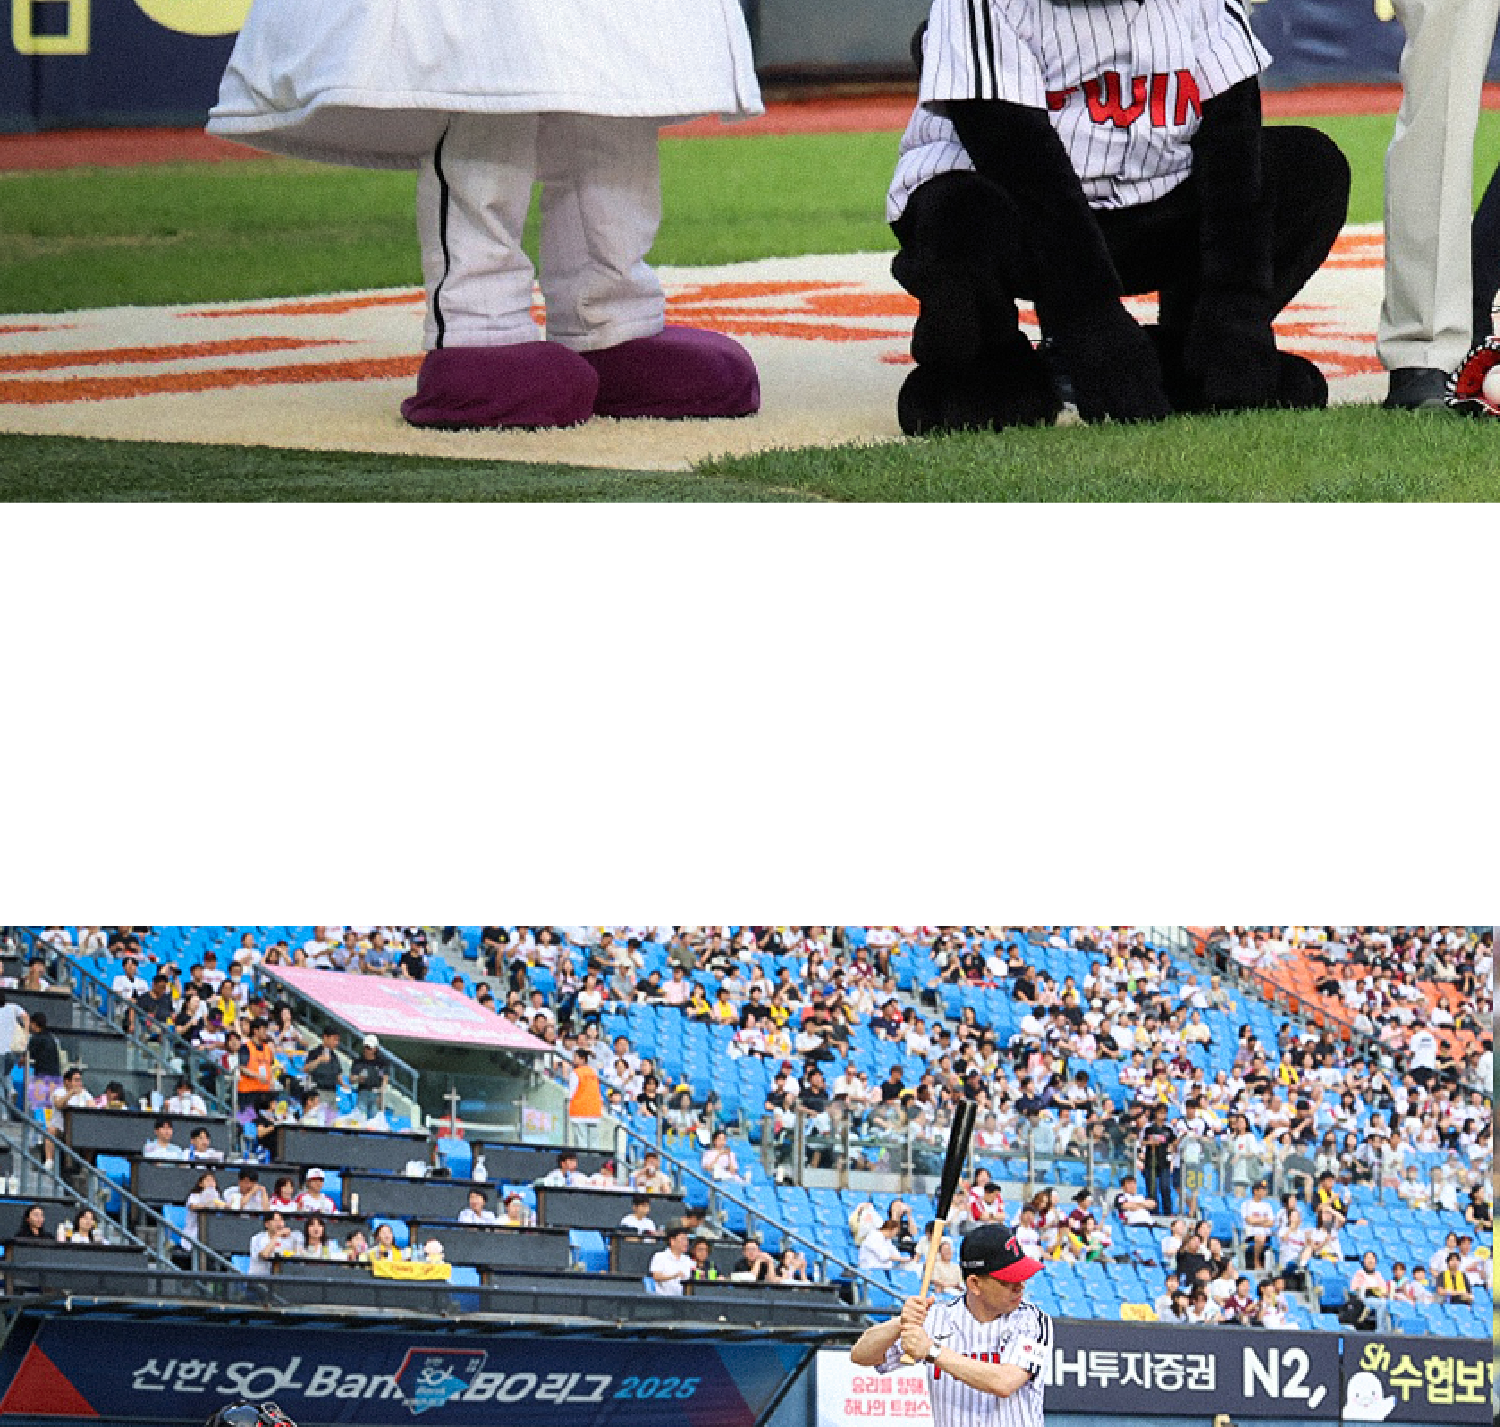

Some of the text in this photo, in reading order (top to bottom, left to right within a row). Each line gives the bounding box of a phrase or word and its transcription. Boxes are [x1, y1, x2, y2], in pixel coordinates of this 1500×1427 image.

[1047, 1346, 1328, 1409] H투자증권 N2,
[1360, 1342, 1390, 1372] Sh
[1389, 1354, 1493, 1405] 수협보
[131, 1359, 217, 1392] 신한
[450, 1371, 537, 1402] BO
[535, 1372, 613, 1404] 리그
[613, 1376, 700, 1399] 2025
